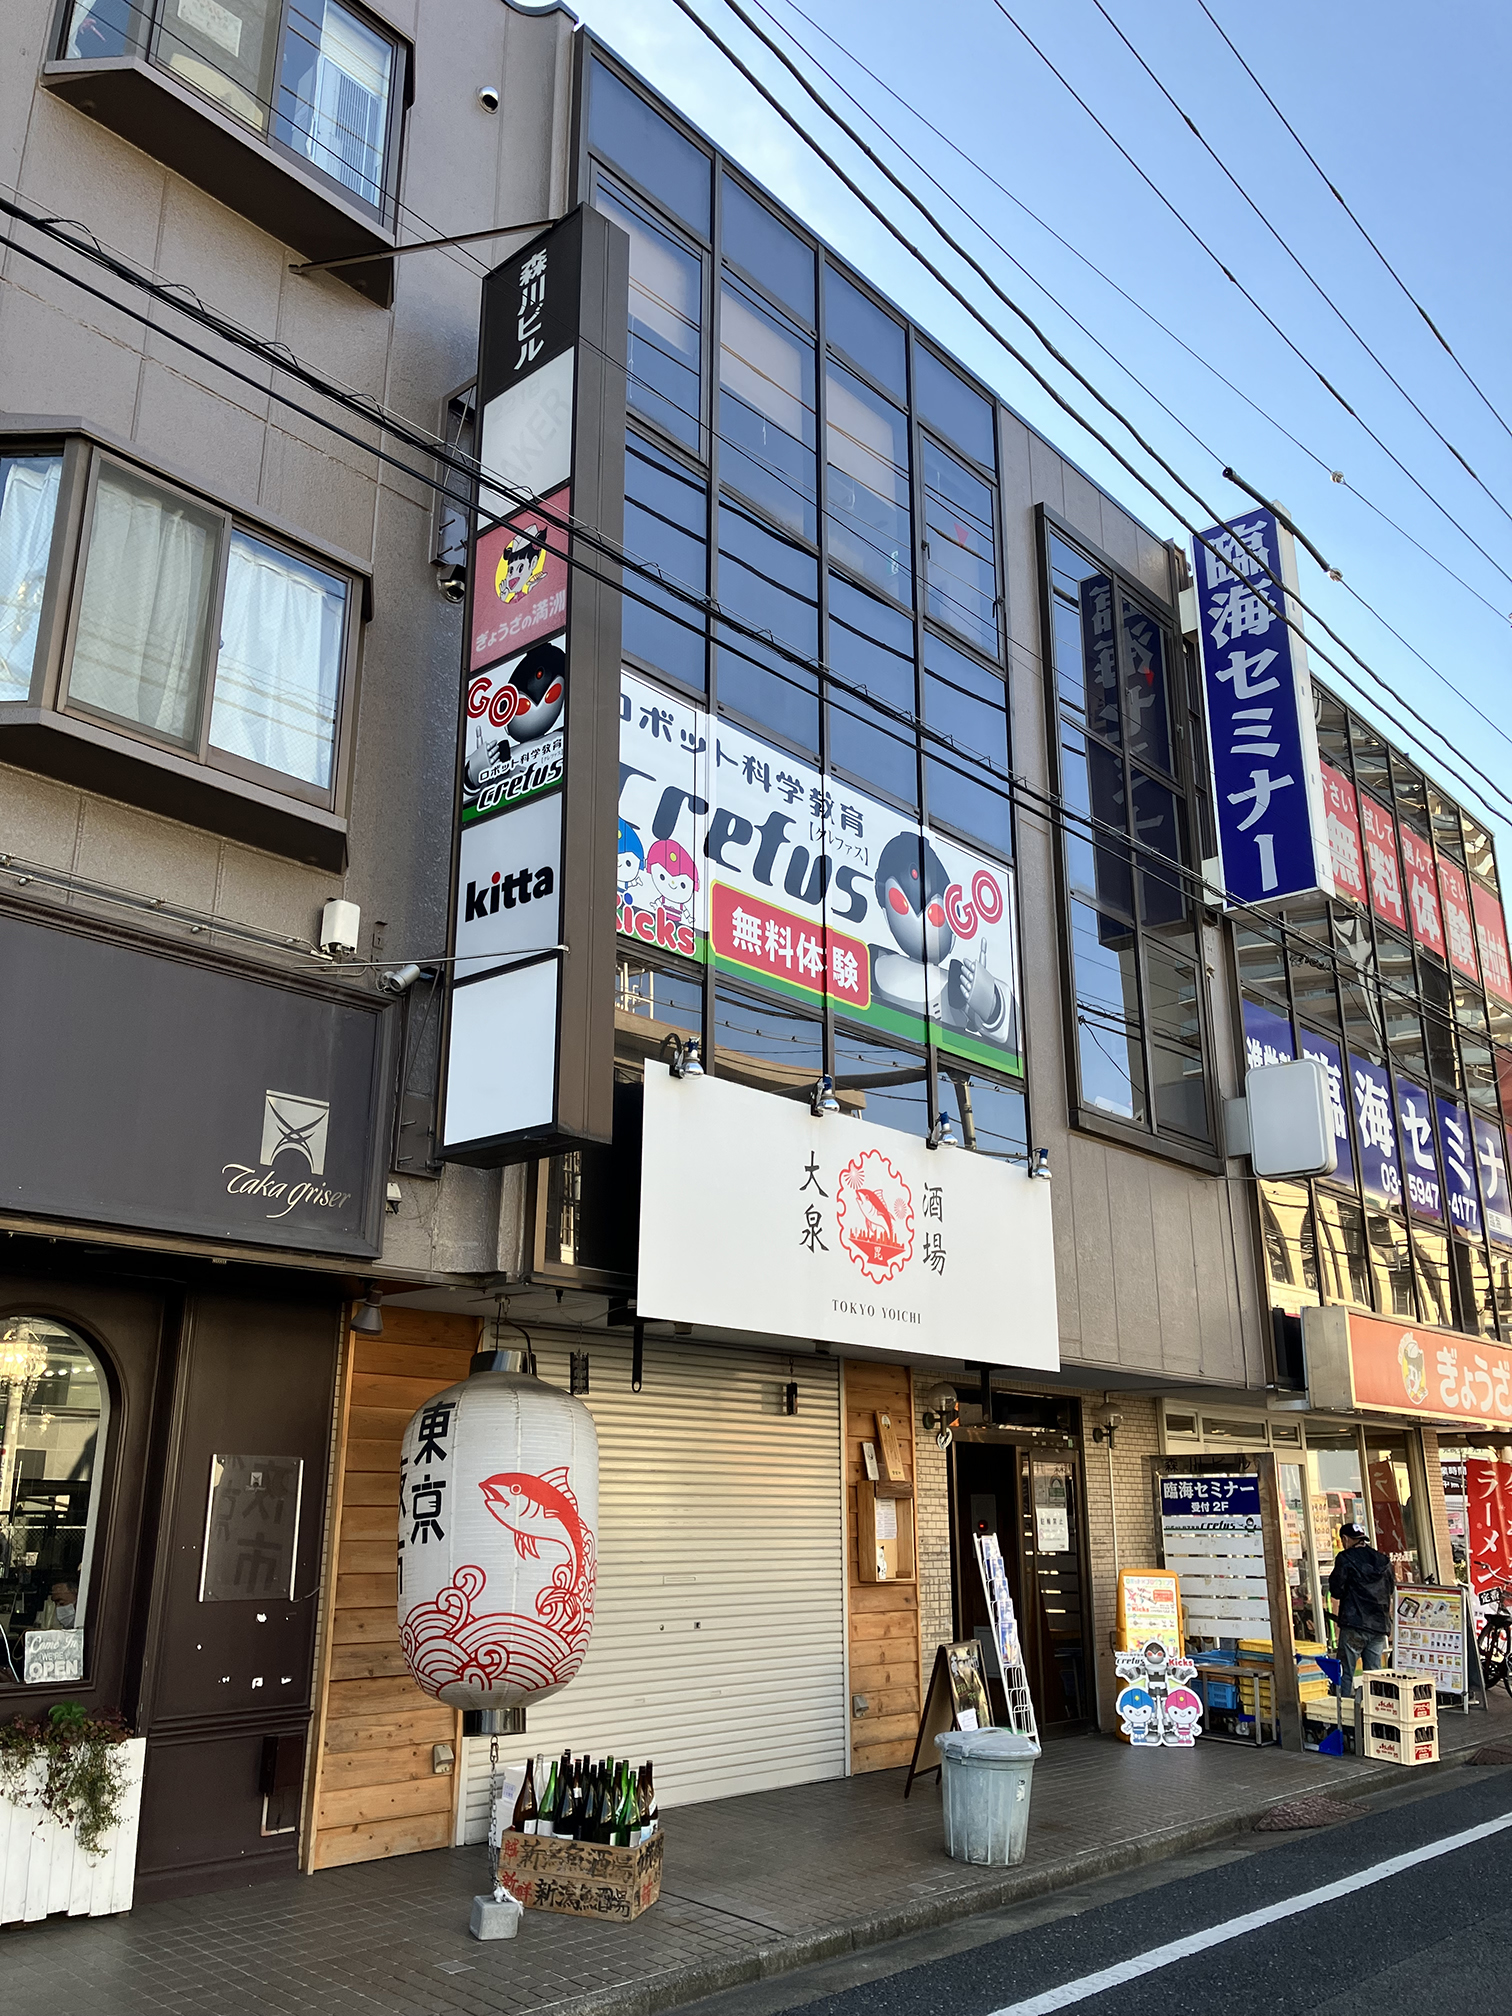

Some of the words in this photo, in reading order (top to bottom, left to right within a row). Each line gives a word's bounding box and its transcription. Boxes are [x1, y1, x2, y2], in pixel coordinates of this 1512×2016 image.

[513, 247, 548, 371] 森川ビル
[475, 588, 566, 652] ぎょうざの満洲
[467, 677, 519, 727] GO
[1204, 519, 1295, 893] 臨海セミナー
[465, 866, 554, 923] kitta
[944, 869, 1003, 940] GO
[731, 907, 860, 994] 無料体験
[222, 1163, 288, 1199] Taka
[266, 1181, 352, 1219] griser
[798, 1150, 830, 1254] 大泉
[1380, 1161, 1478, 1225] 03-5947-4177
[922, 1181, 947, 1277] 酒場
[831, 1298, 875, 1317] TOKYO
[881, 1306, 922, 1325] YOICHI
[410, 1400, 457, 1545] 東京
[1163, 1480, 1256, 1500] 臨海セミナー
[1164, 1456, 1252, 1473] 森川ビル
[1191, 1502, 1210, 1513] 受付
[1212, 1502, 1230, 1512] 2F
[29, 1660, 79, 1678] OPEN
[1168, 1658, 1193, 1667] Kicks
